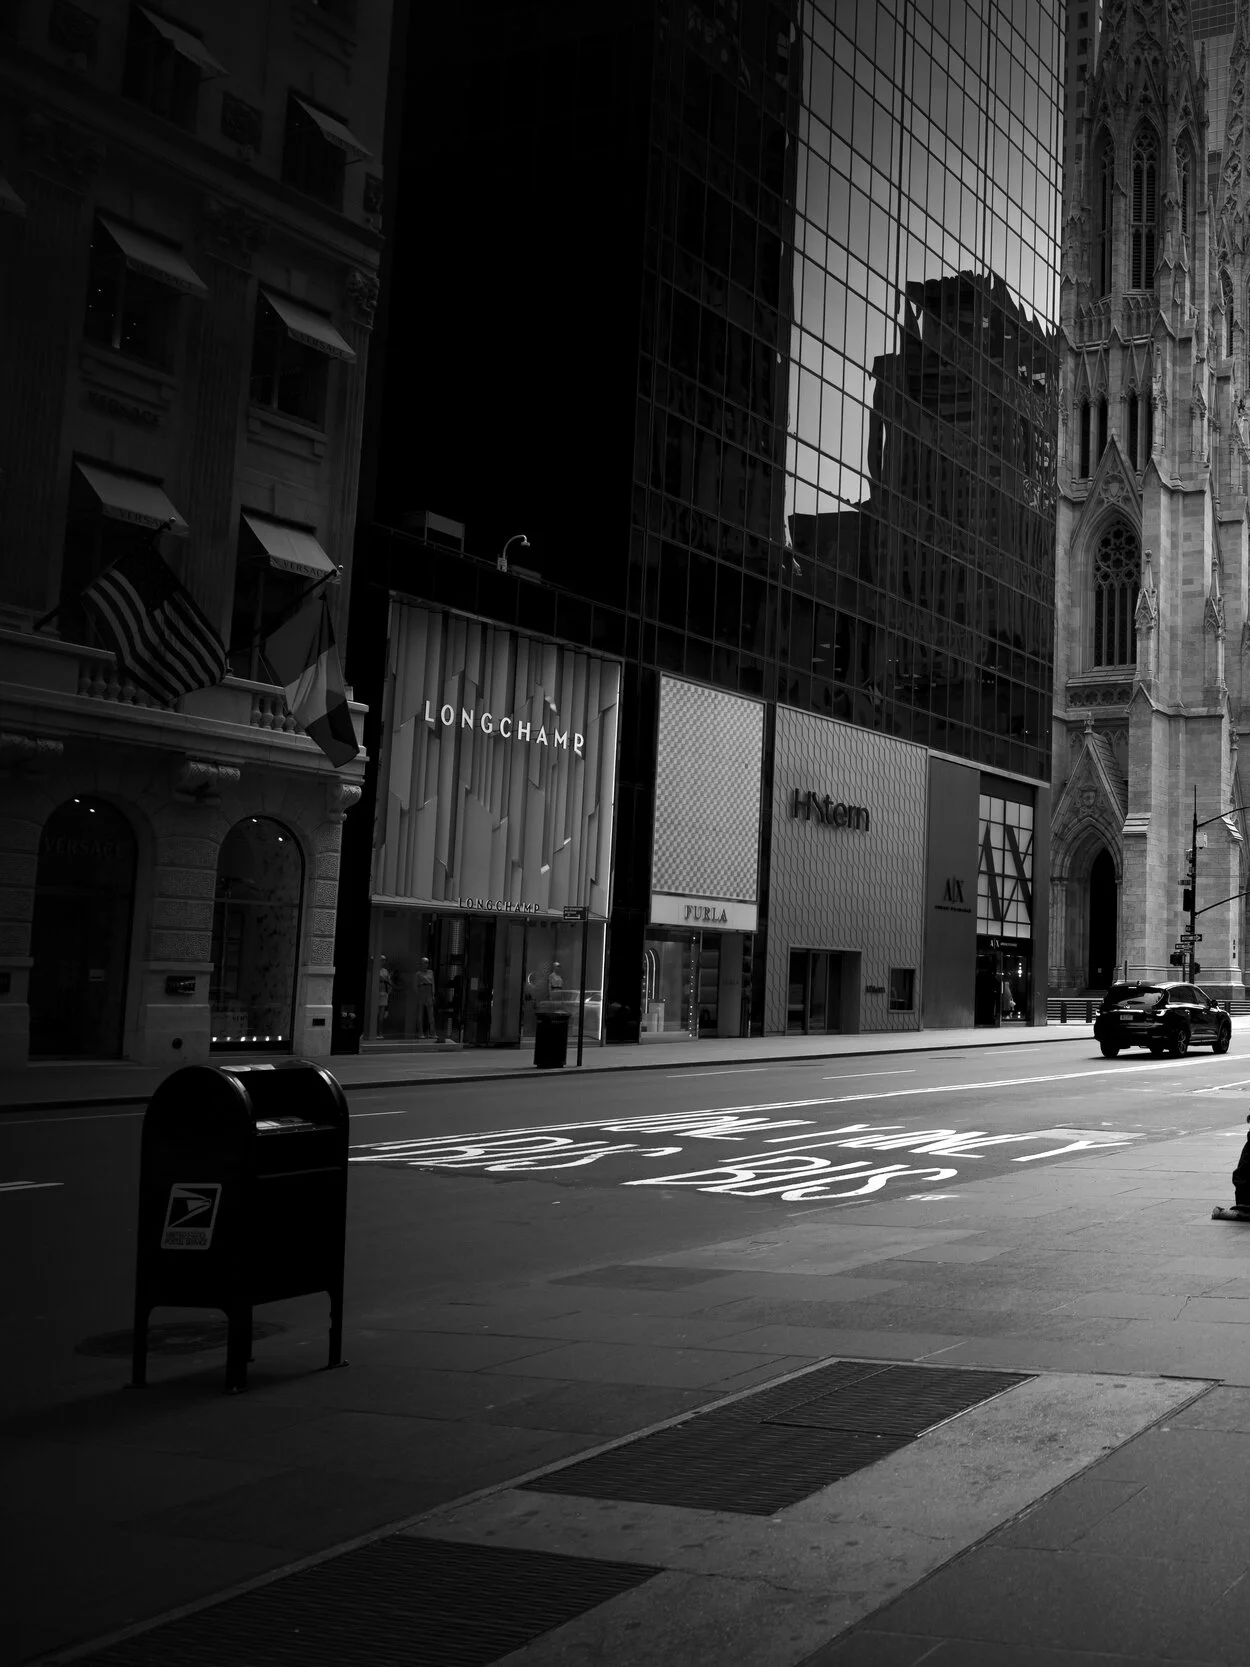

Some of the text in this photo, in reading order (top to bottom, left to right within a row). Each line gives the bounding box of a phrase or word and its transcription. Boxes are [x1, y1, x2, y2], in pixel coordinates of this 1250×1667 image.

[425, 700, 584, 758] LONGCHAMP
[458, 897, 540, 915] LONGCHAMP
[684, 904, 728, 923] FURLA
[347, 1136, 683, 1171] BUS
[616, 1155, 958, 1201] BUS
